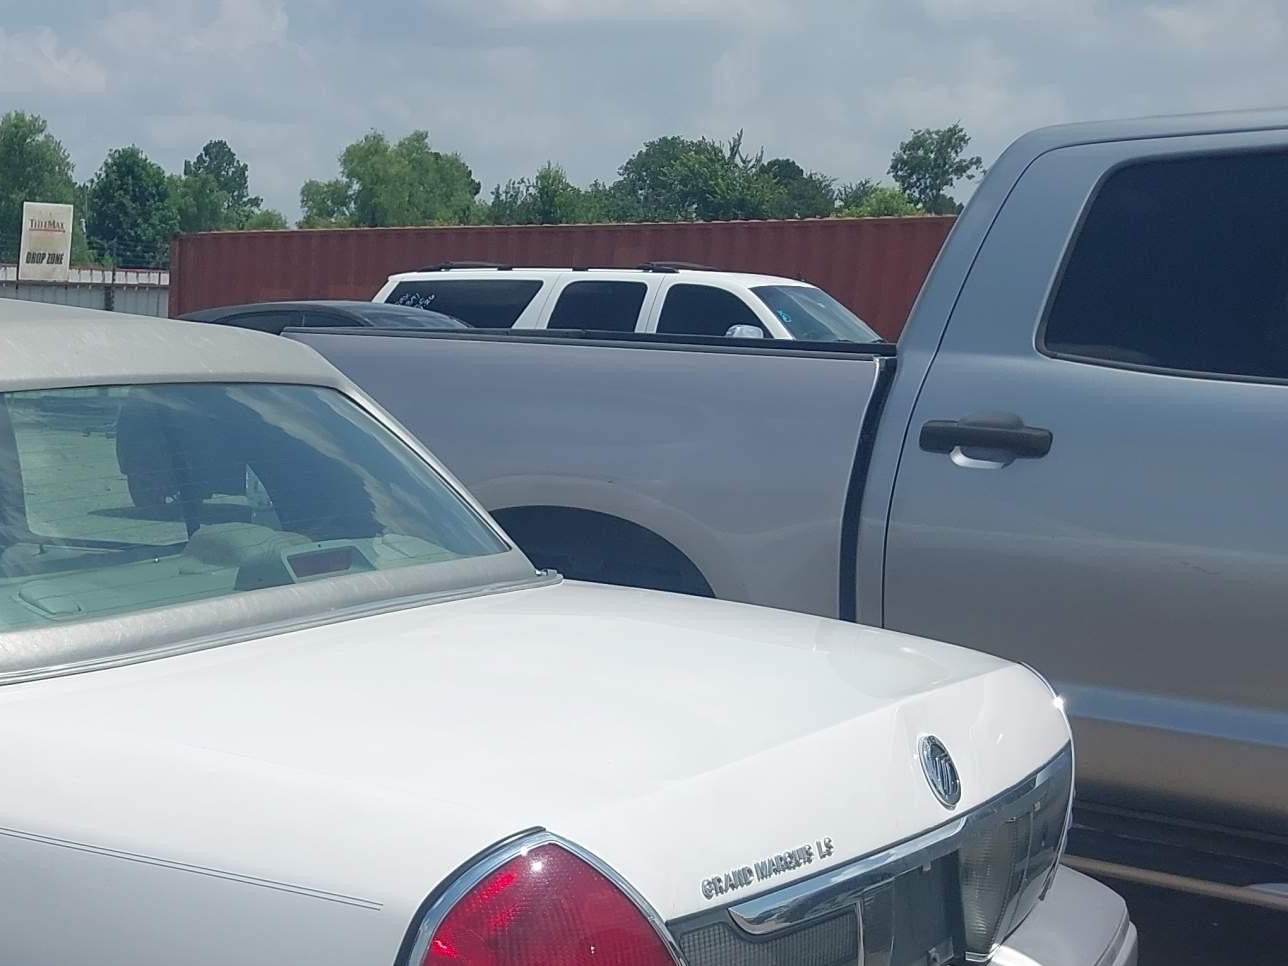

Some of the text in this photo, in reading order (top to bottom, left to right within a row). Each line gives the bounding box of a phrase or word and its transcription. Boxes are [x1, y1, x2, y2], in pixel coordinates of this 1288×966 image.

[25, 252, 65, 265] DROP ZONE
[701, 836, 834, 901] GRAND MARQUIS LS
